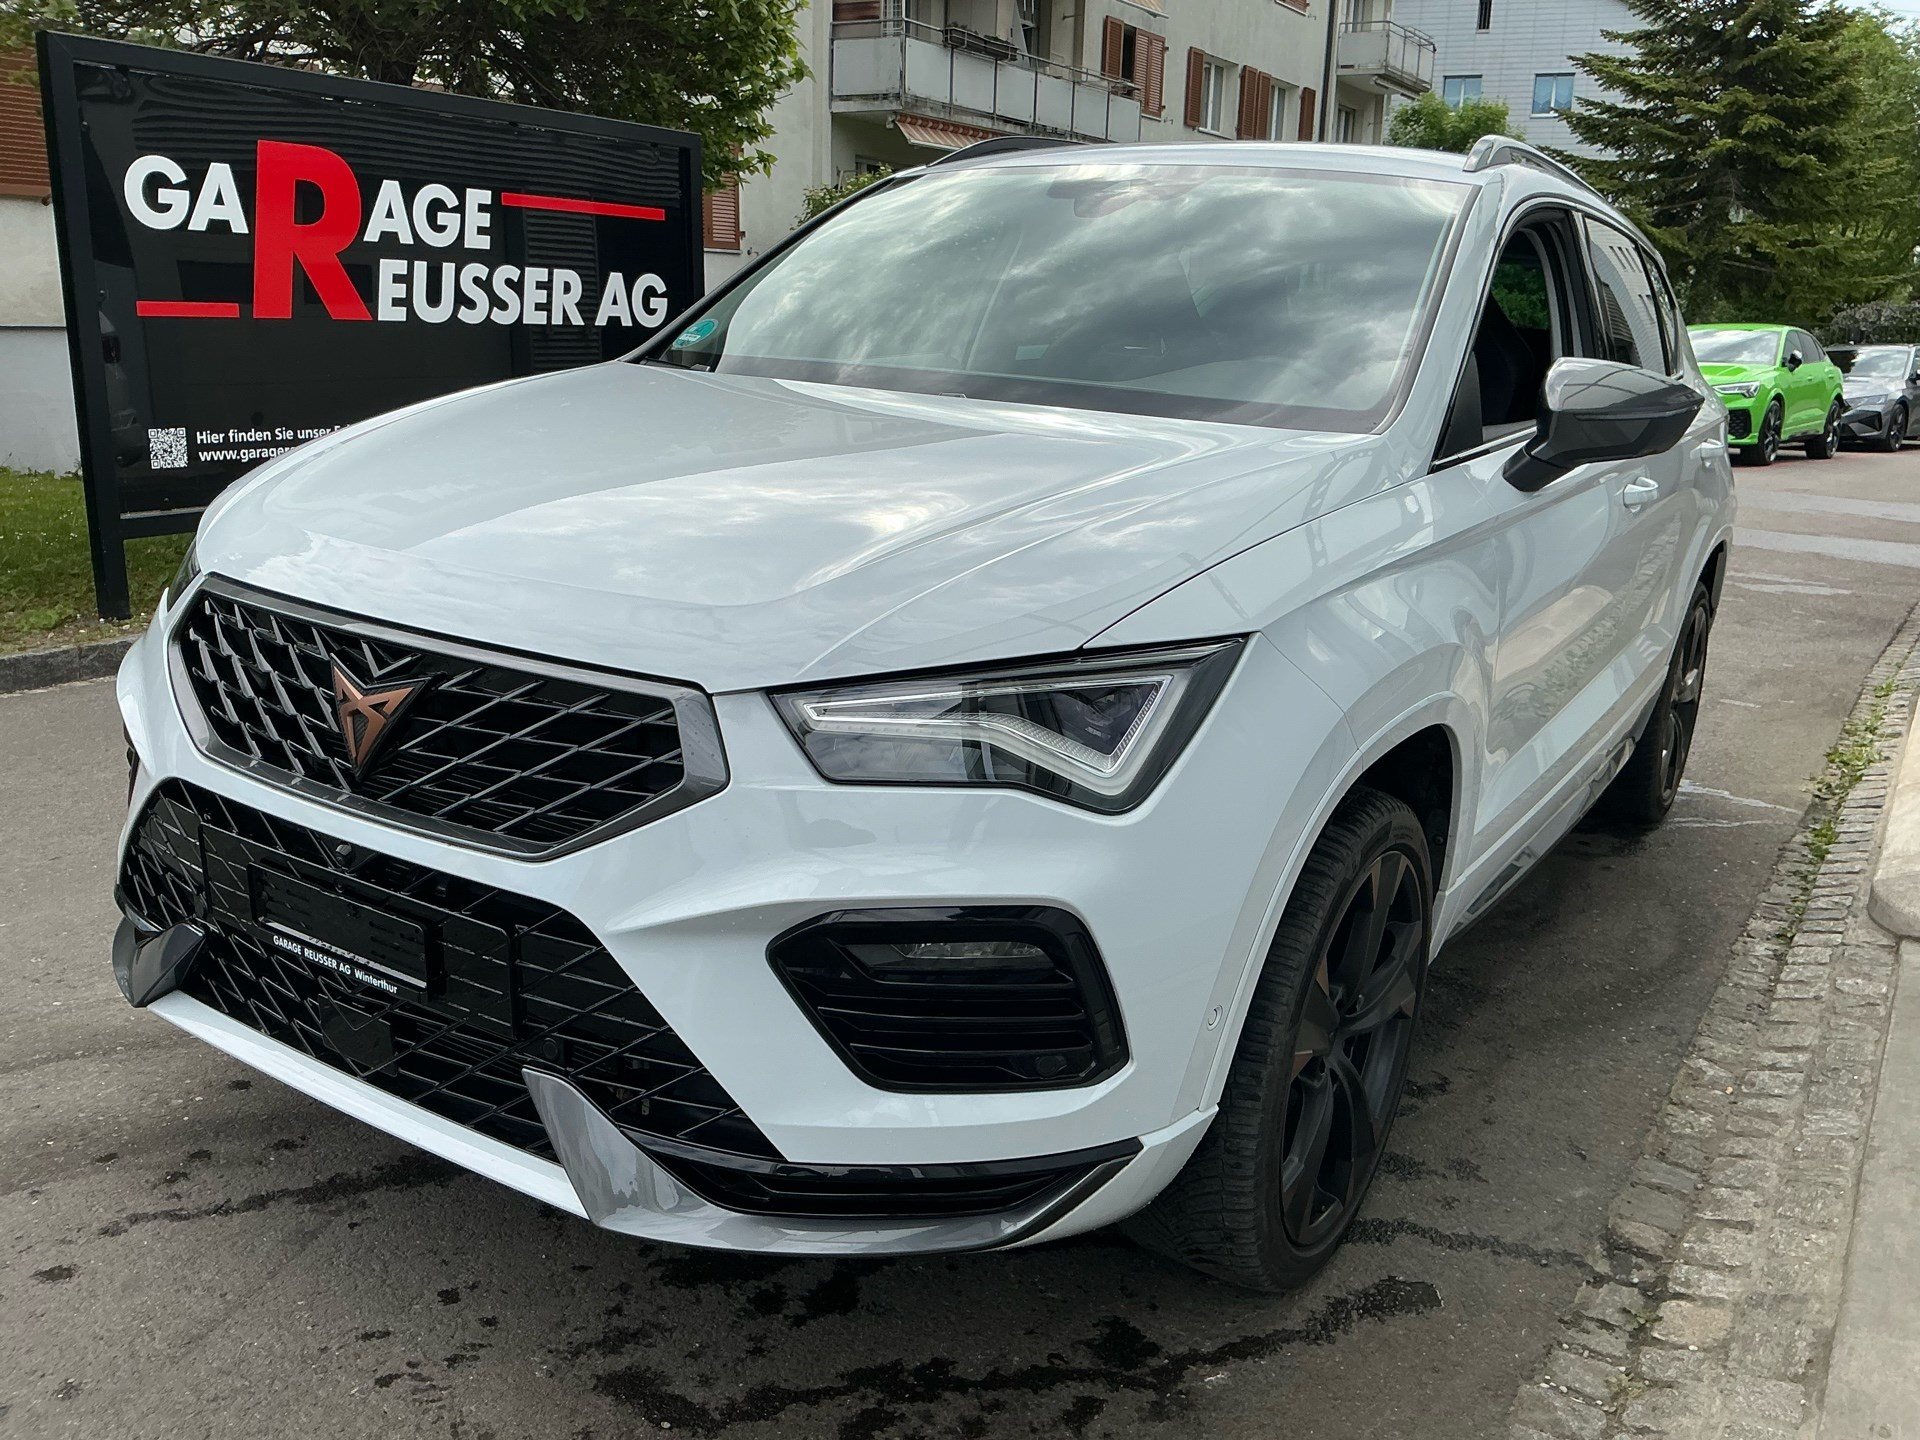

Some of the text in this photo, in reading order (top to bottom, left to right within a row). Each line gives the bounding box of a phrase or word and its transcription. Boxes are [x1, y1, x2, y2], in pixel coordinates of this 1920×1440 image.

[124, 140, 492, 320] GARAGE
[594, 272, 668, 327] AG
[197, 430, 226, 445] Hier
[228, 428, 272, 443] finden
[275, 427, 294, 441] Sie
[273, 935, 398, 994] GARAGE REUSSER AG Winterthur
